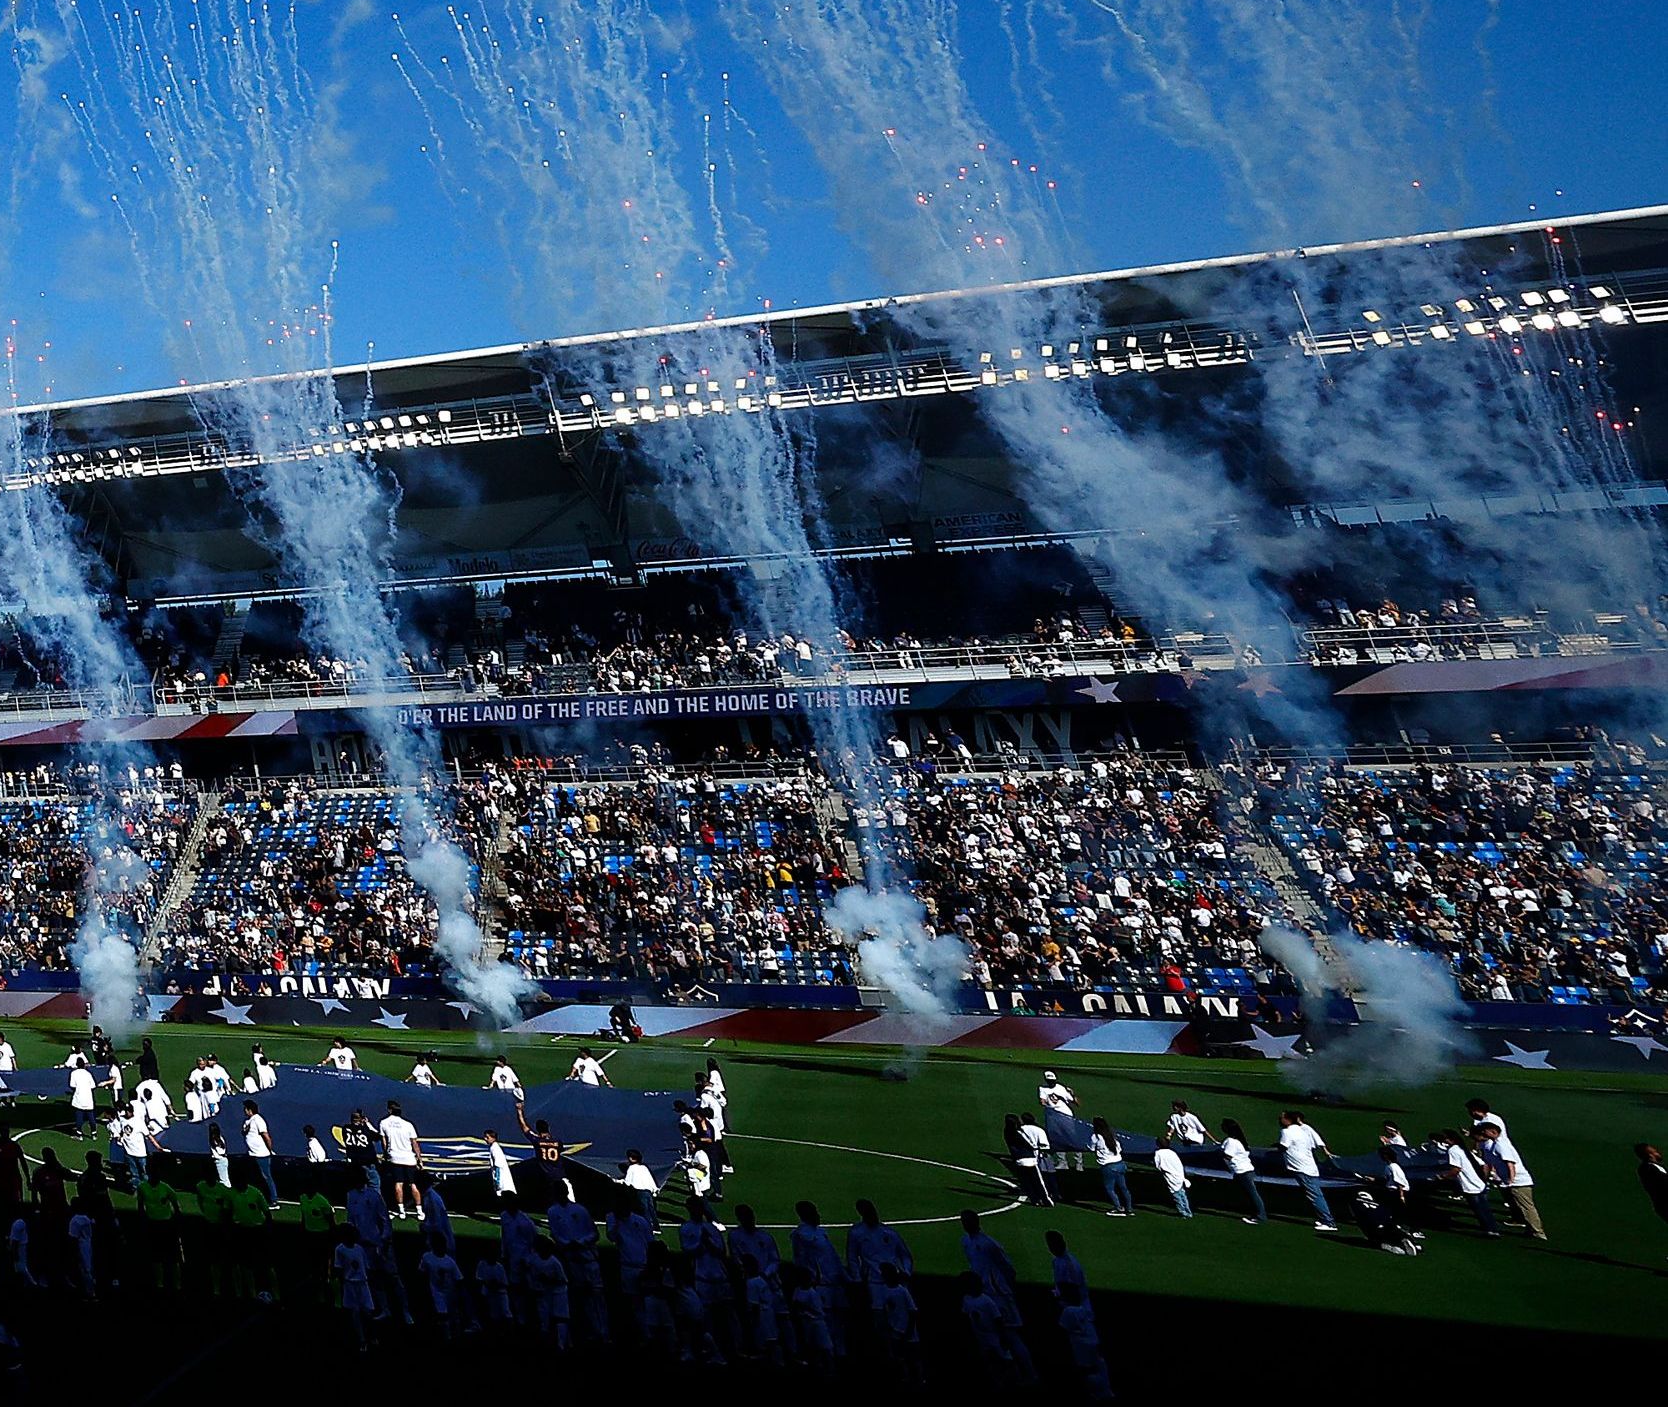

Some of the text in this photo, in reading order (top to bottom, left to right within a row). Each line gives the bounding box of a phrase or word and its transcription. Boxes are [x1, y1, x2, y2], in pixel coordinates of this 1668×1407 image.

[438, 707, 468, 723] THE
[473, 705, 516, 721] LAND
[522, 704, 543, 720] OF
[550, 702, 580, 718] THE
[586, 700, 628, 717] FREE
[633, 698, 669, 714] AND
[675, 696, 709, 713] THE
[715, 694, 769, 711] HOME
[776, 692, 798, 709] OF
[807, 690, 840, 708] THE
[847, 688, 911, 707] BRAVE
[540, 1147, 559, 1162] 10
